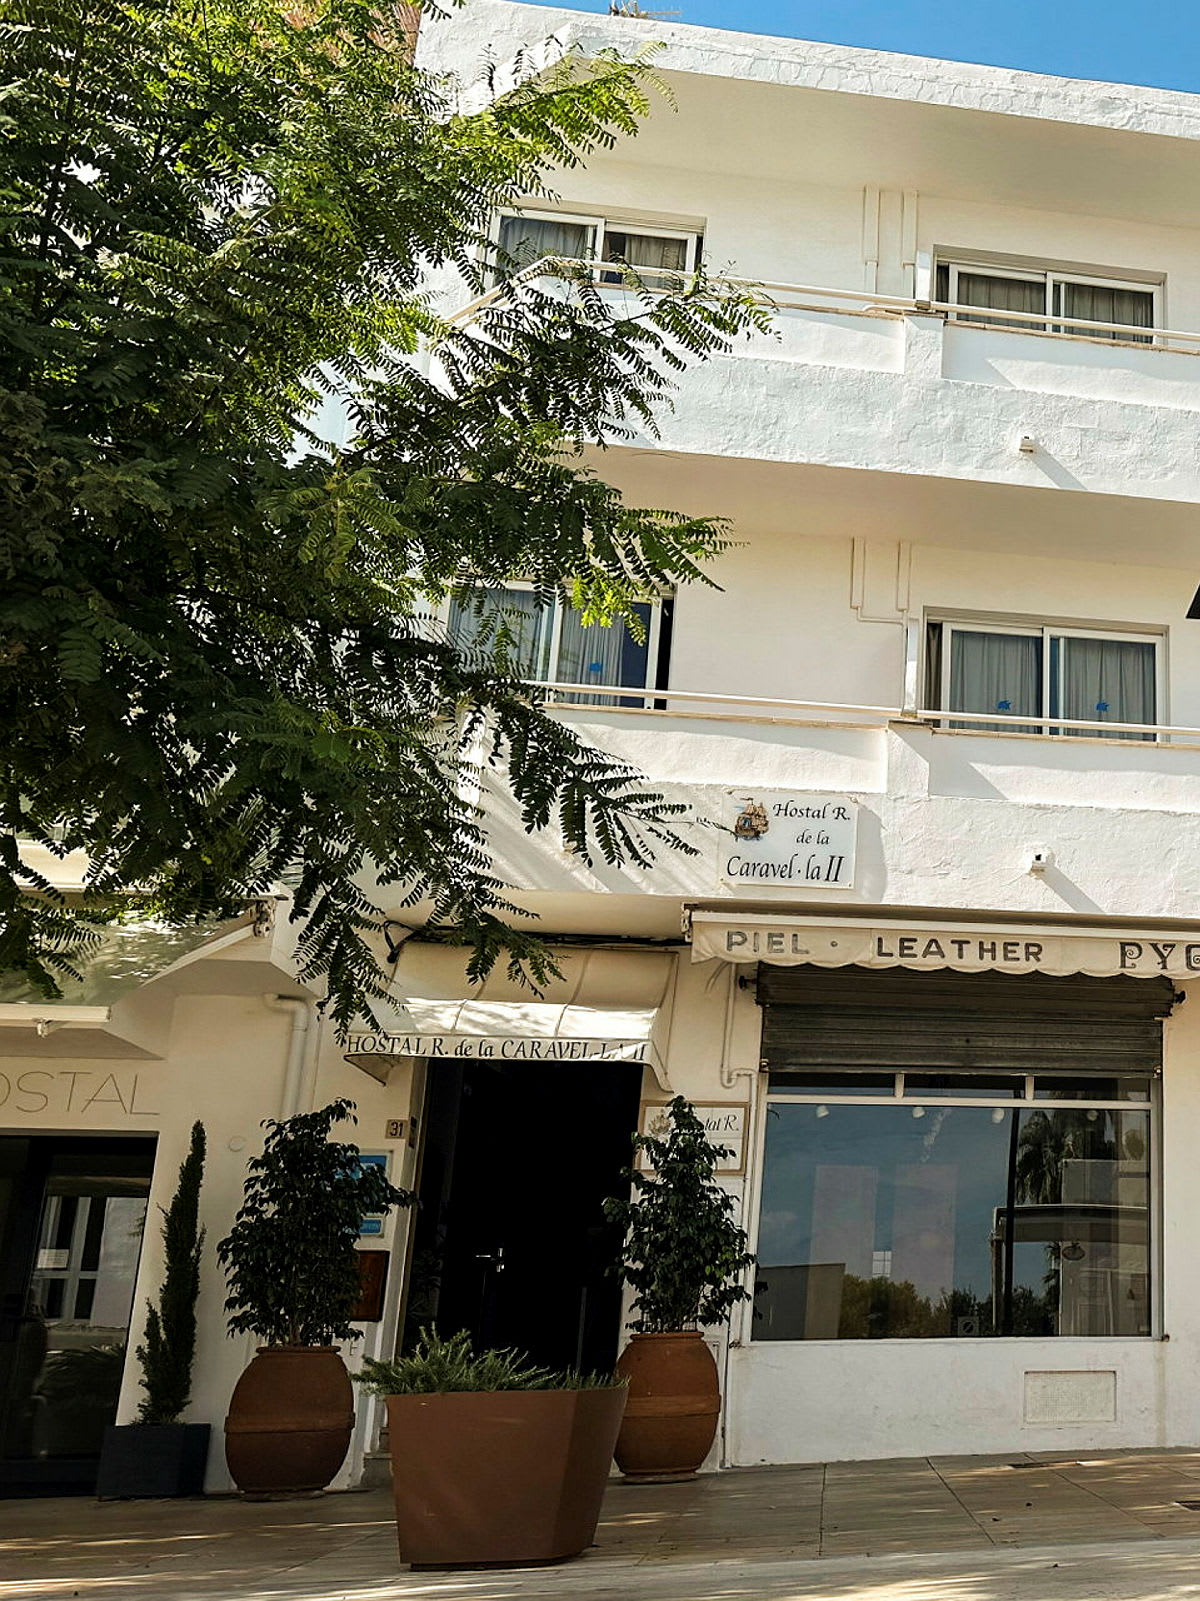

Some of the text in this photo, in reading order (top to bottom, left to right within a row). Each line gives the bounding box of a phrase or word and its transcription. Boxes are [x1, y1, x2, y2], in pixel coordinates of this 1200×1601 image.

[773, 800, 850, 820] Hostal R.
[796, 829, 830, 845] de la
[824, 855, 845, 882] II
[726, 930, 810, 955] PIEL
[876, 936, 1044, 963] LEATHER
[346, 1034, 426, 1055] HOSTAL
[431, 1037, 448, 1055] R.
[455, 1039, 472, 1056] de
[479, 1039, 494, 1057] la
[501, 1040, 624, 1060] CARAVEL-L
[0, 1071, 160, 1116] STAL
[389, 1121, 403, 1137] 31
[723, 1114, 740, 1132] R.
